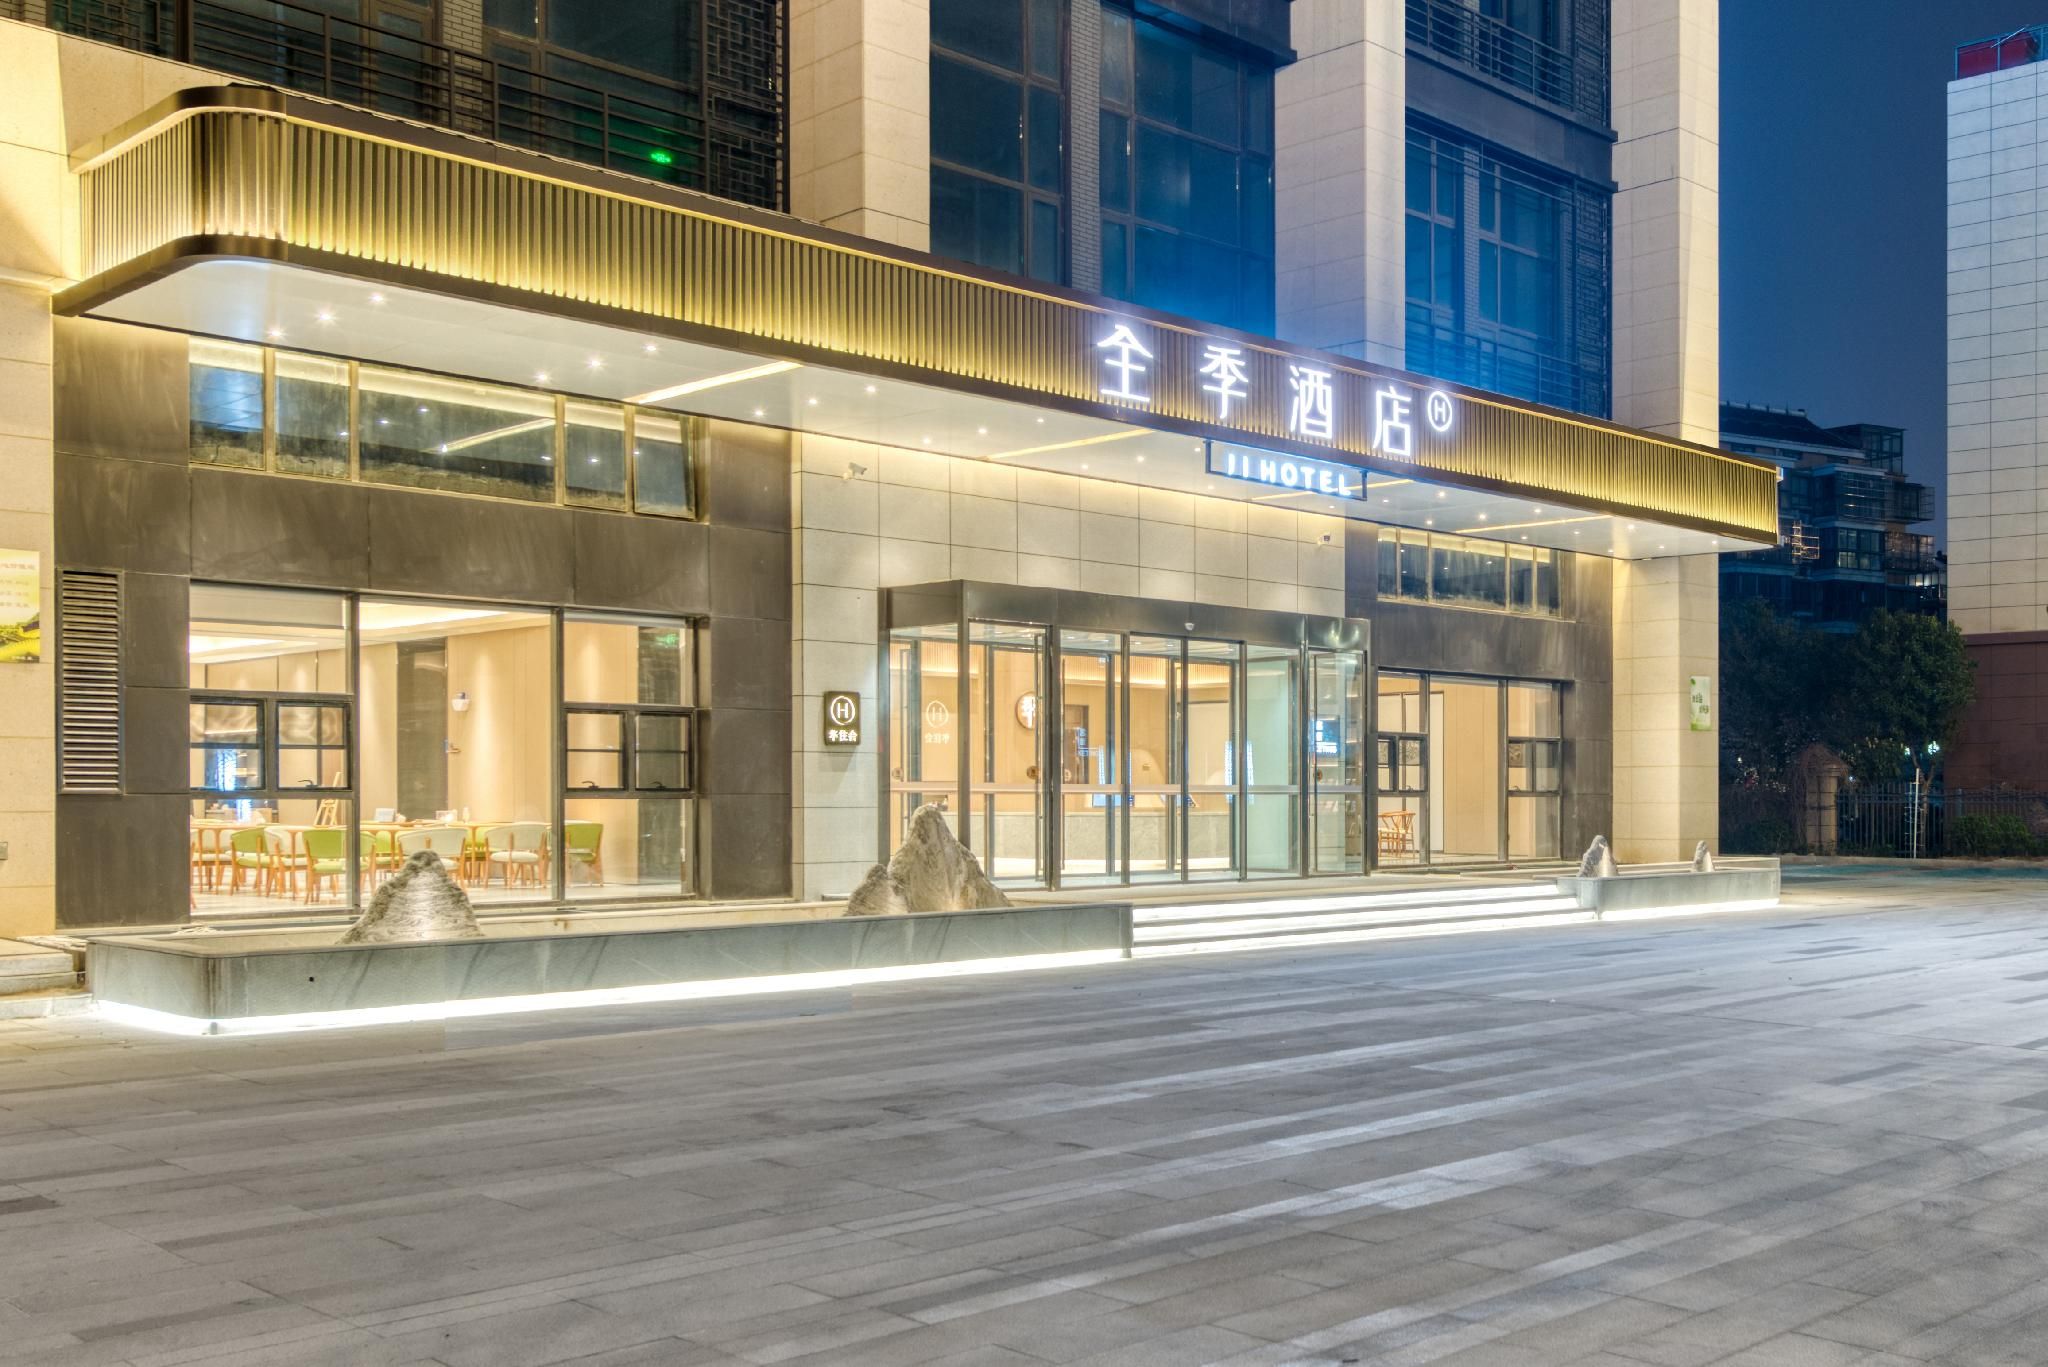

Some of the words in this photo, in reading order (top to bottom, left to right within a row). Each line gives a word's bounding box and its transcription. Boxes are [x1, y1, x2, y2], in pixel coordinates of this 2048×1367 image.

[1097, 324, 1412, 457] 全季酒店
[1260, 459, 1352, 496] HOTEL
